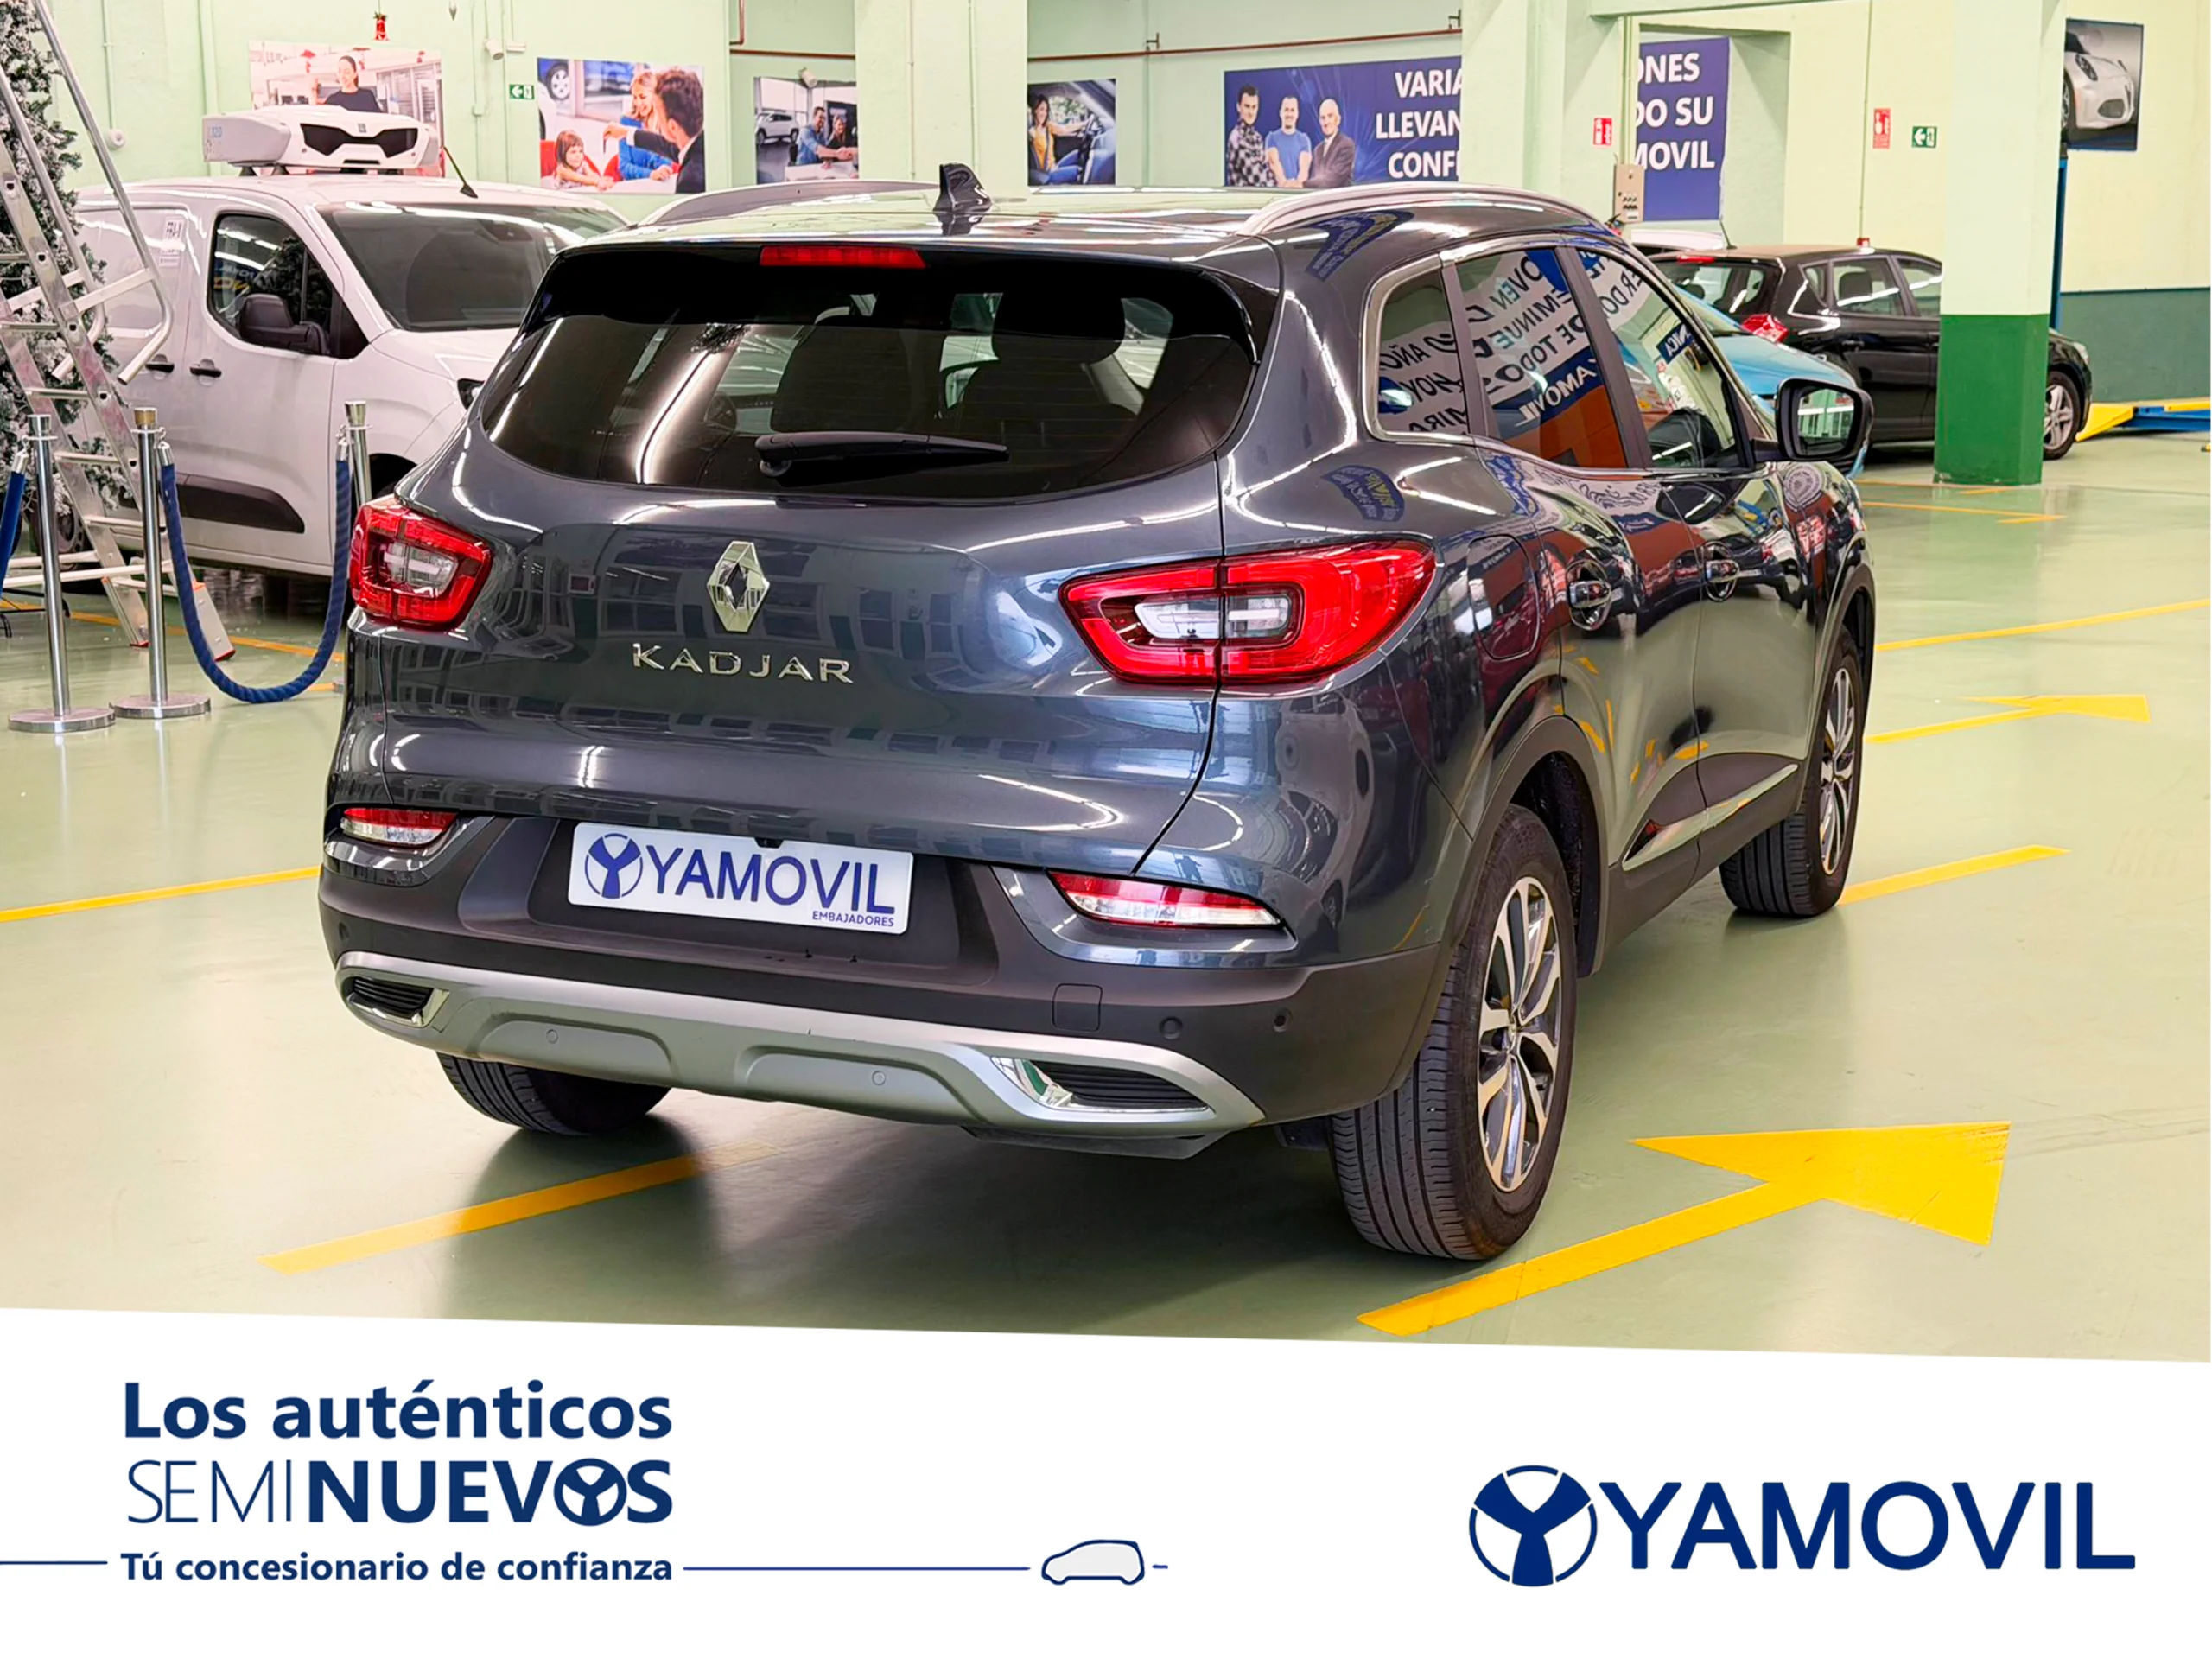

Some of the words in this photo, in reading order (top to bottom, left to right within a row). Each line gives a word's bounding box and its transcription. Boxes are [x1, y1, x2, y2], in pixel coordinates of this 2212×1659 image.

[1638, 52, 1700, 84] NES
[1675, 95, 1713, 127] SU
[632, 643, 854, 684] KADJAR
[645, 844, 895, 915] YAMOVIL
[811, 910, 895, 928] EMBAJADORES
